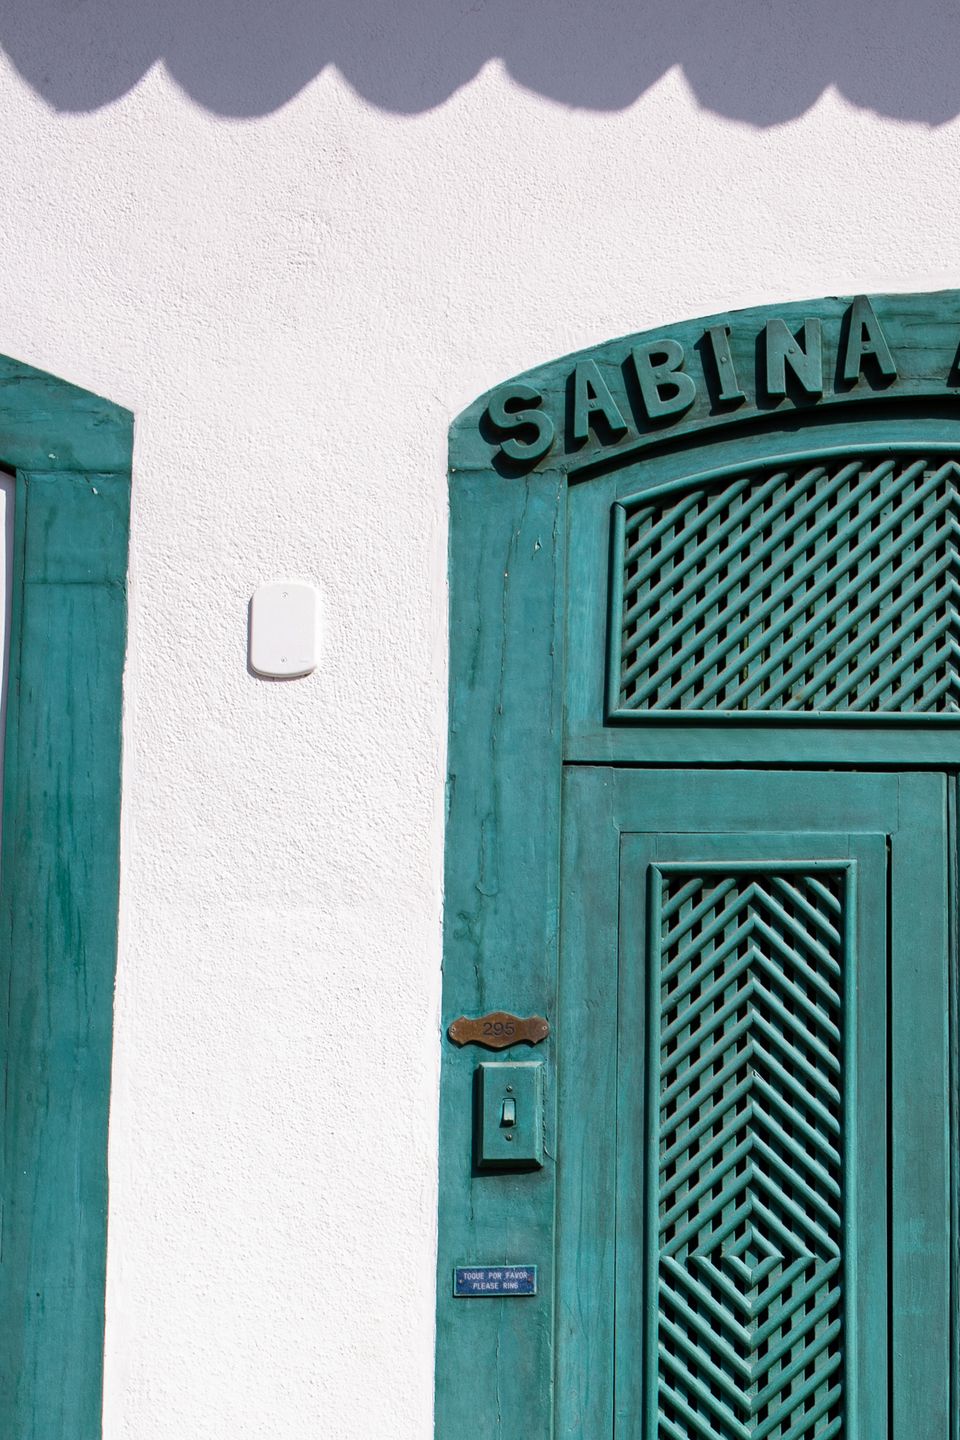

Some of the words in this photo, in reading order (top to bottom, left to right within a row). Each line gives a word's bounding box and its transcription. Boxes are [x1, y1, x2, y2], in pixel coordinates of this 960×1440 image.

[486, 295, 900, 461] SABINA
[482, 1022, 516, 1037] 295
[464, 1272, 484, 1280] TOQUE
[488, 1272, 502, 1280] POR
[505, 1271, 528, 1280] FAVOR
[472, 1282, 499, 1290] PLEASE
[502, 1281, 519, 1289] RING
